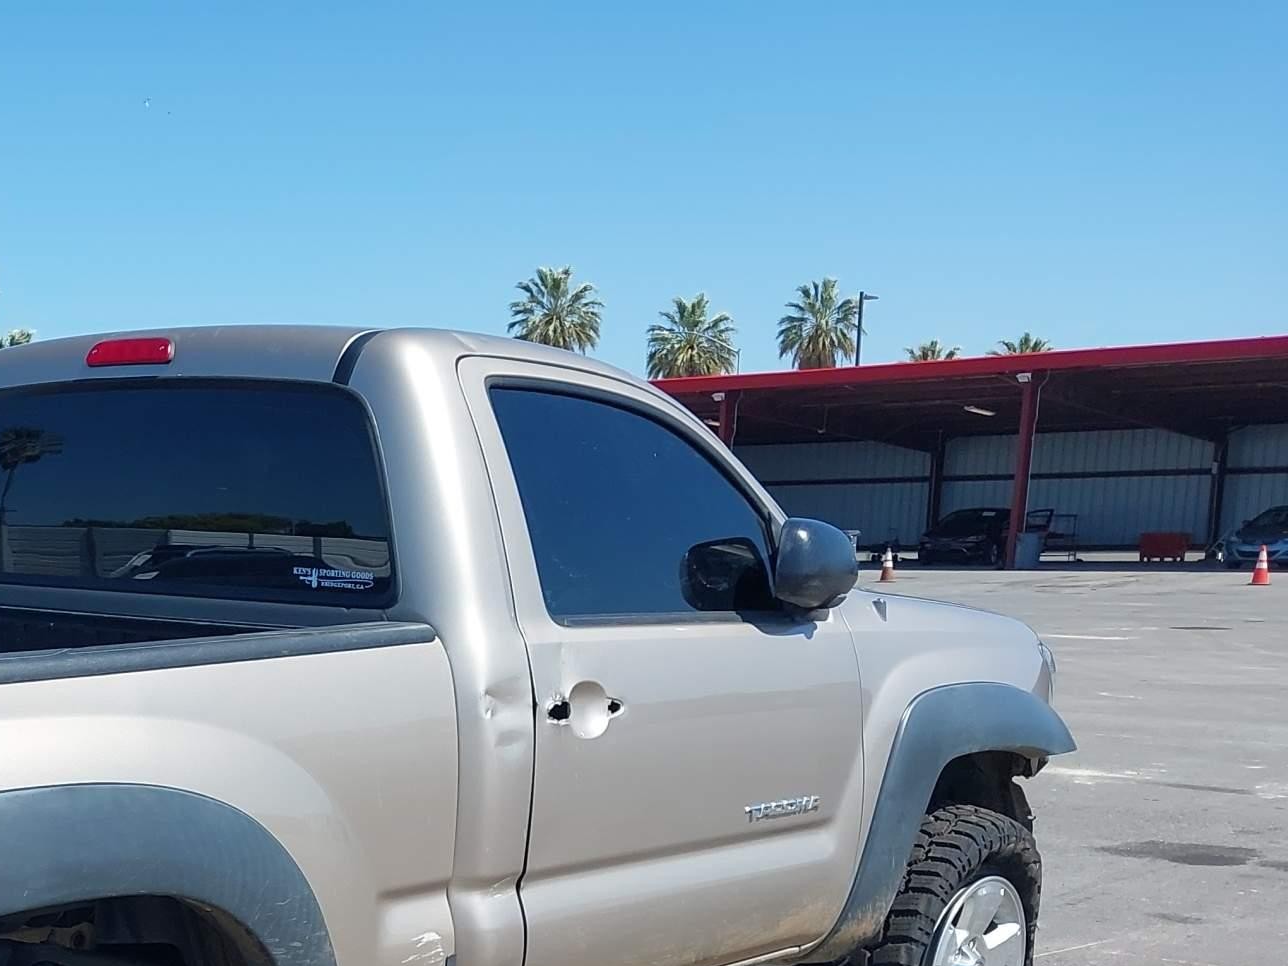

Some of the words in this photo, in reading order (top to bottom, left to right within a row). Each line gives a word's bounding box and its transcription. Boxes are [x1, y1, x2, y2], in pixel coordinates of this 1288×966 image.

[293, 567, 312, 575] KEN'S
[319, 569, 351, 578] SPORTING
[351, 571, 374, 580] GOODS
